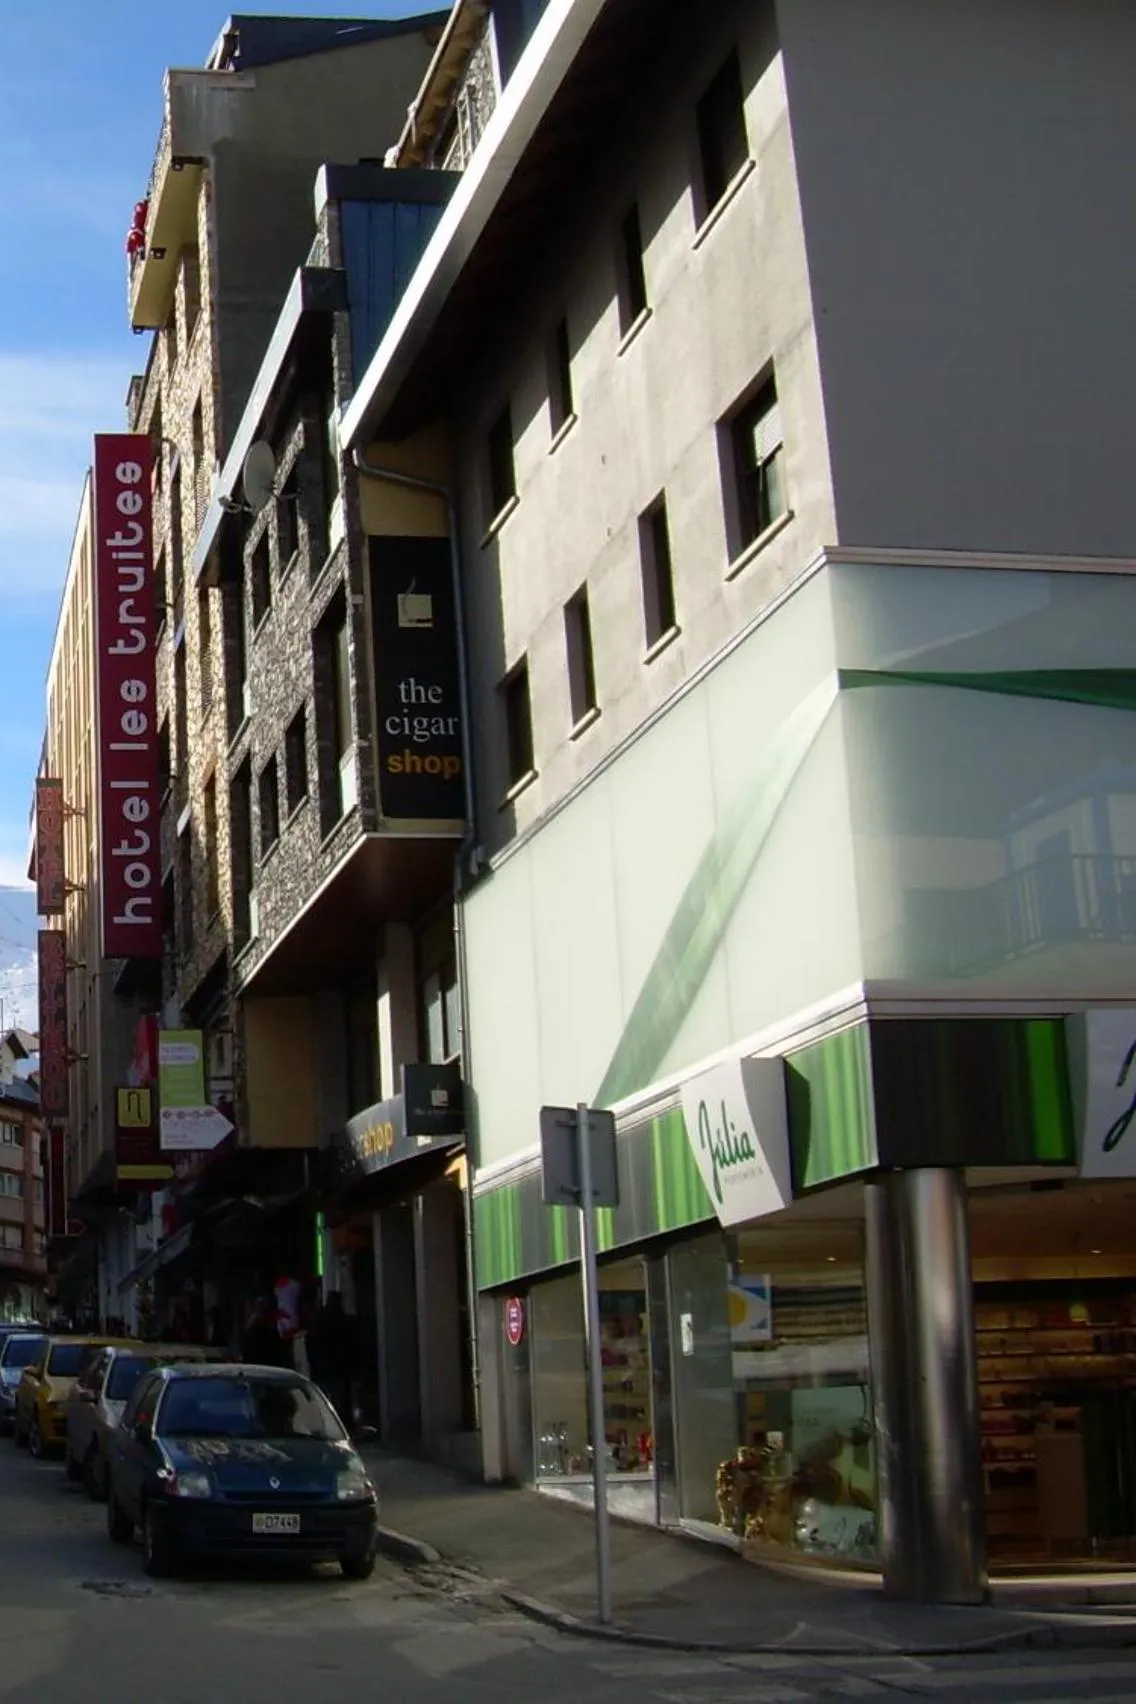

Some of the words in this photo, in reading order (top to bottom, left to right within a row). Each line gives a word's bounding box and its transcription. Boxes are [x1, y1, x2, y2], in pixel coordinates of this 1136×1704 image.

[106, 462, 147, 655] truites
[109, 679, 149, 750] les
[398, 677, 443, 704] the
[385, 707, 459, 743] cigar
[387, 748, 461, 780] shop
[110, 781, 152, 924] hotel
